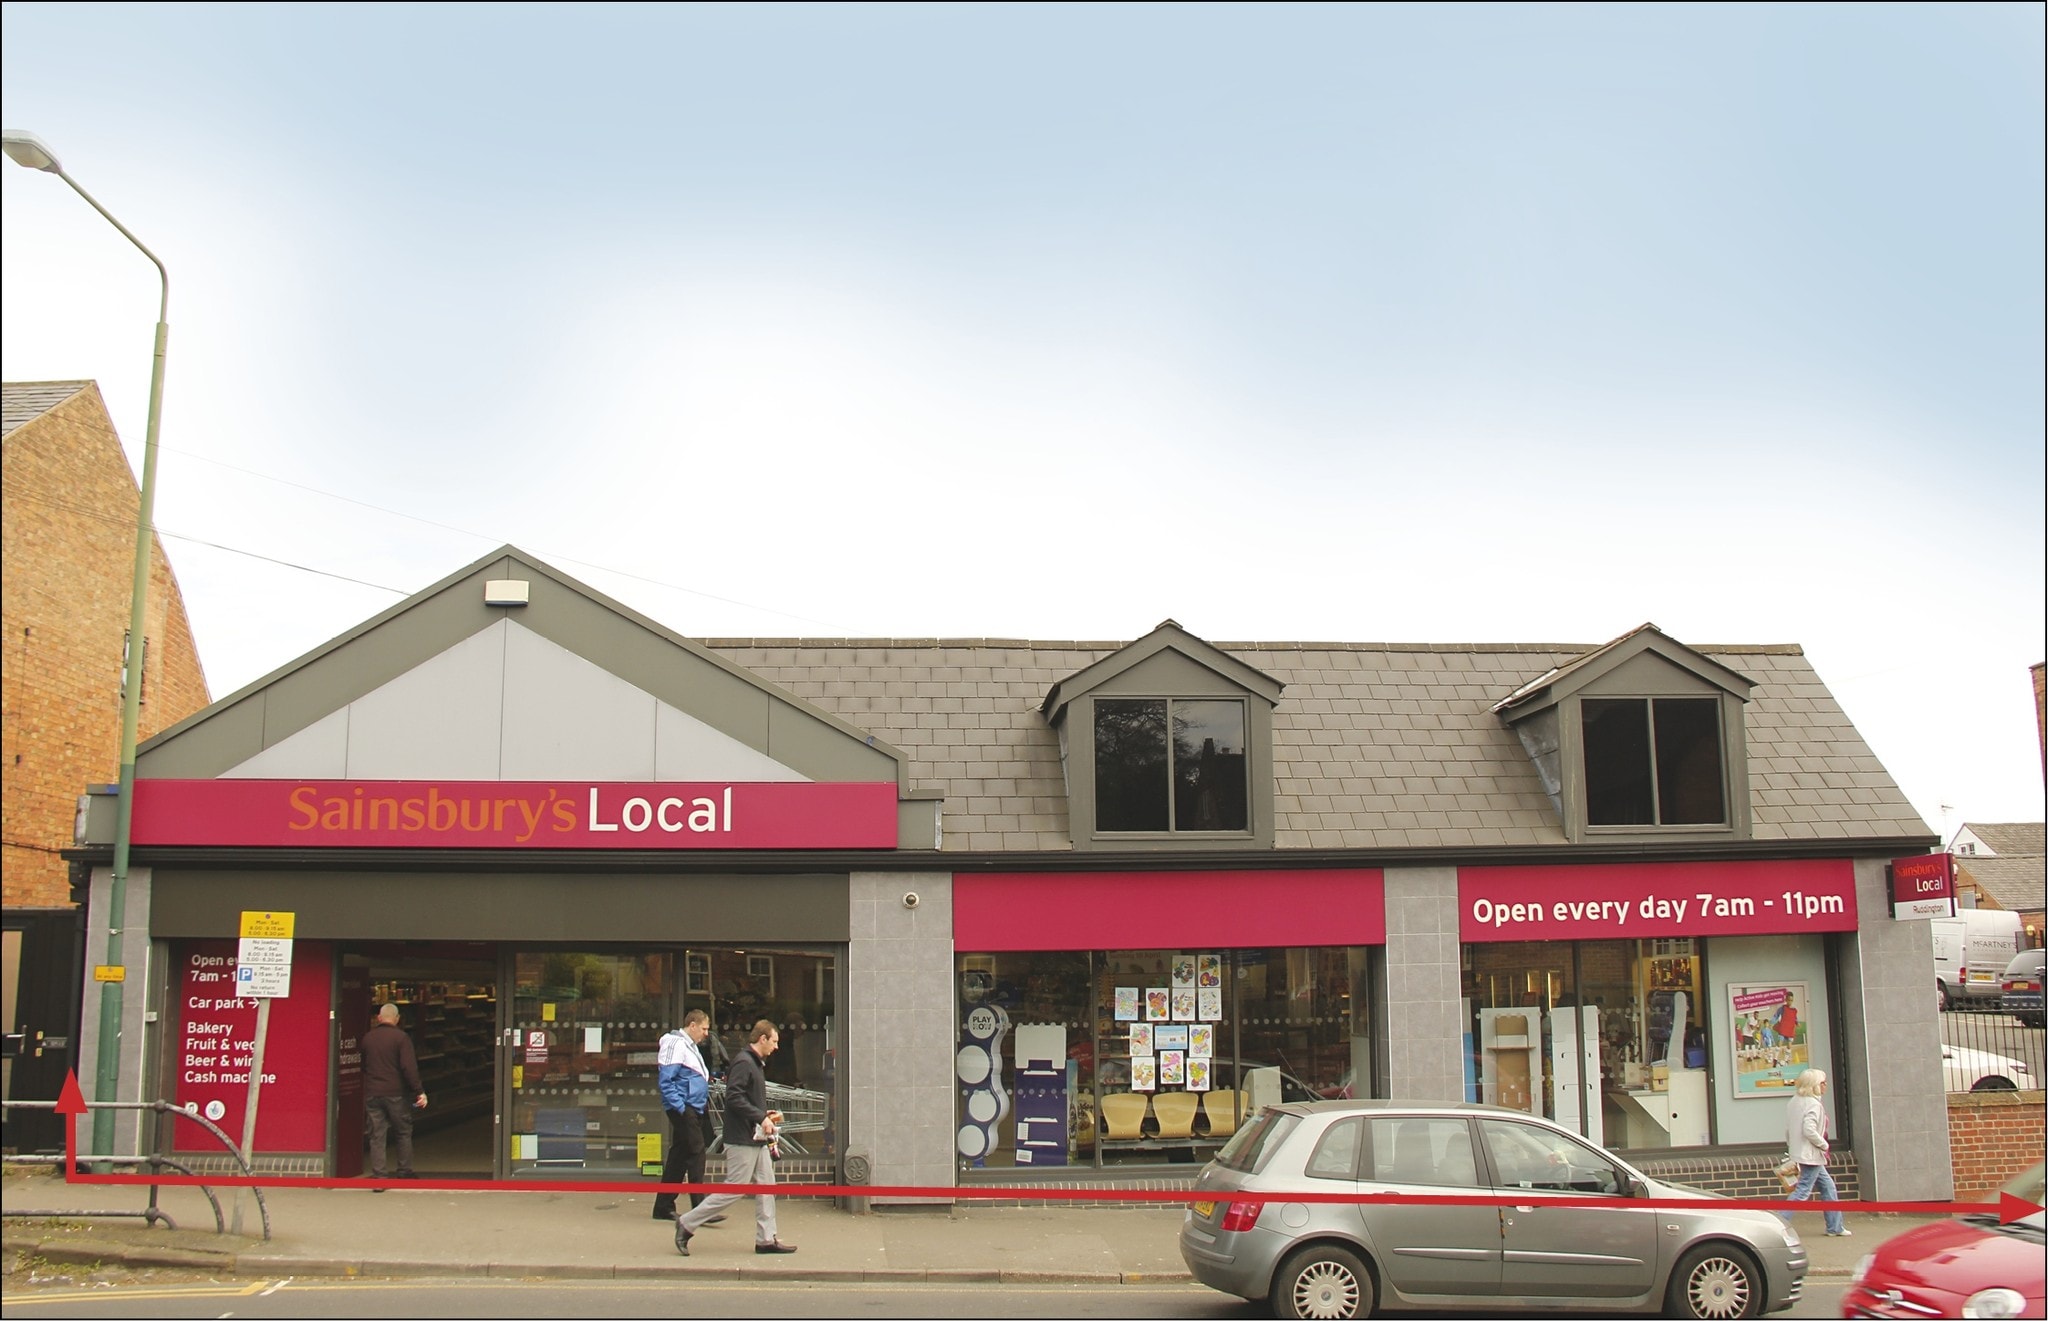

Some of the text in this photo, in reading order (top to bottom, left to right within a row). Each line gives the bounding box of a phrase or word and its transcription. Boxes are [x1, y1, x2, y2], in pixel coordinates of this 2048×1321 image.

[288, 786, 732, 843] Sainsbury's Local
[1916, 875, 1943, 892] Local
[1473, 898, 1544, 928] Open
[1553, 900, 1630, 925] every
[1639, 894, 1688, 923] day
[1696, 893, 1755, 917] 7am
[1782, 891, 1844, 919] 11pm
[1912, 904, 1944, 914] Ruddington
[191, 954, 224, 968] Open
[190, 970, 219, 982] 7am
[241, 969, 251, 980] P
[189, 996, 245, 1011] Car park
[187, 1021, 234, 1037] Bakery
[186, 1038, 217, 1050] Fruit
[220, 1038, 230, 1050] &
[185, 1054, 217, 1067] Beer
[220, 1054, 230, 1067] &
[185, 1070, 217, 1083] Cash
